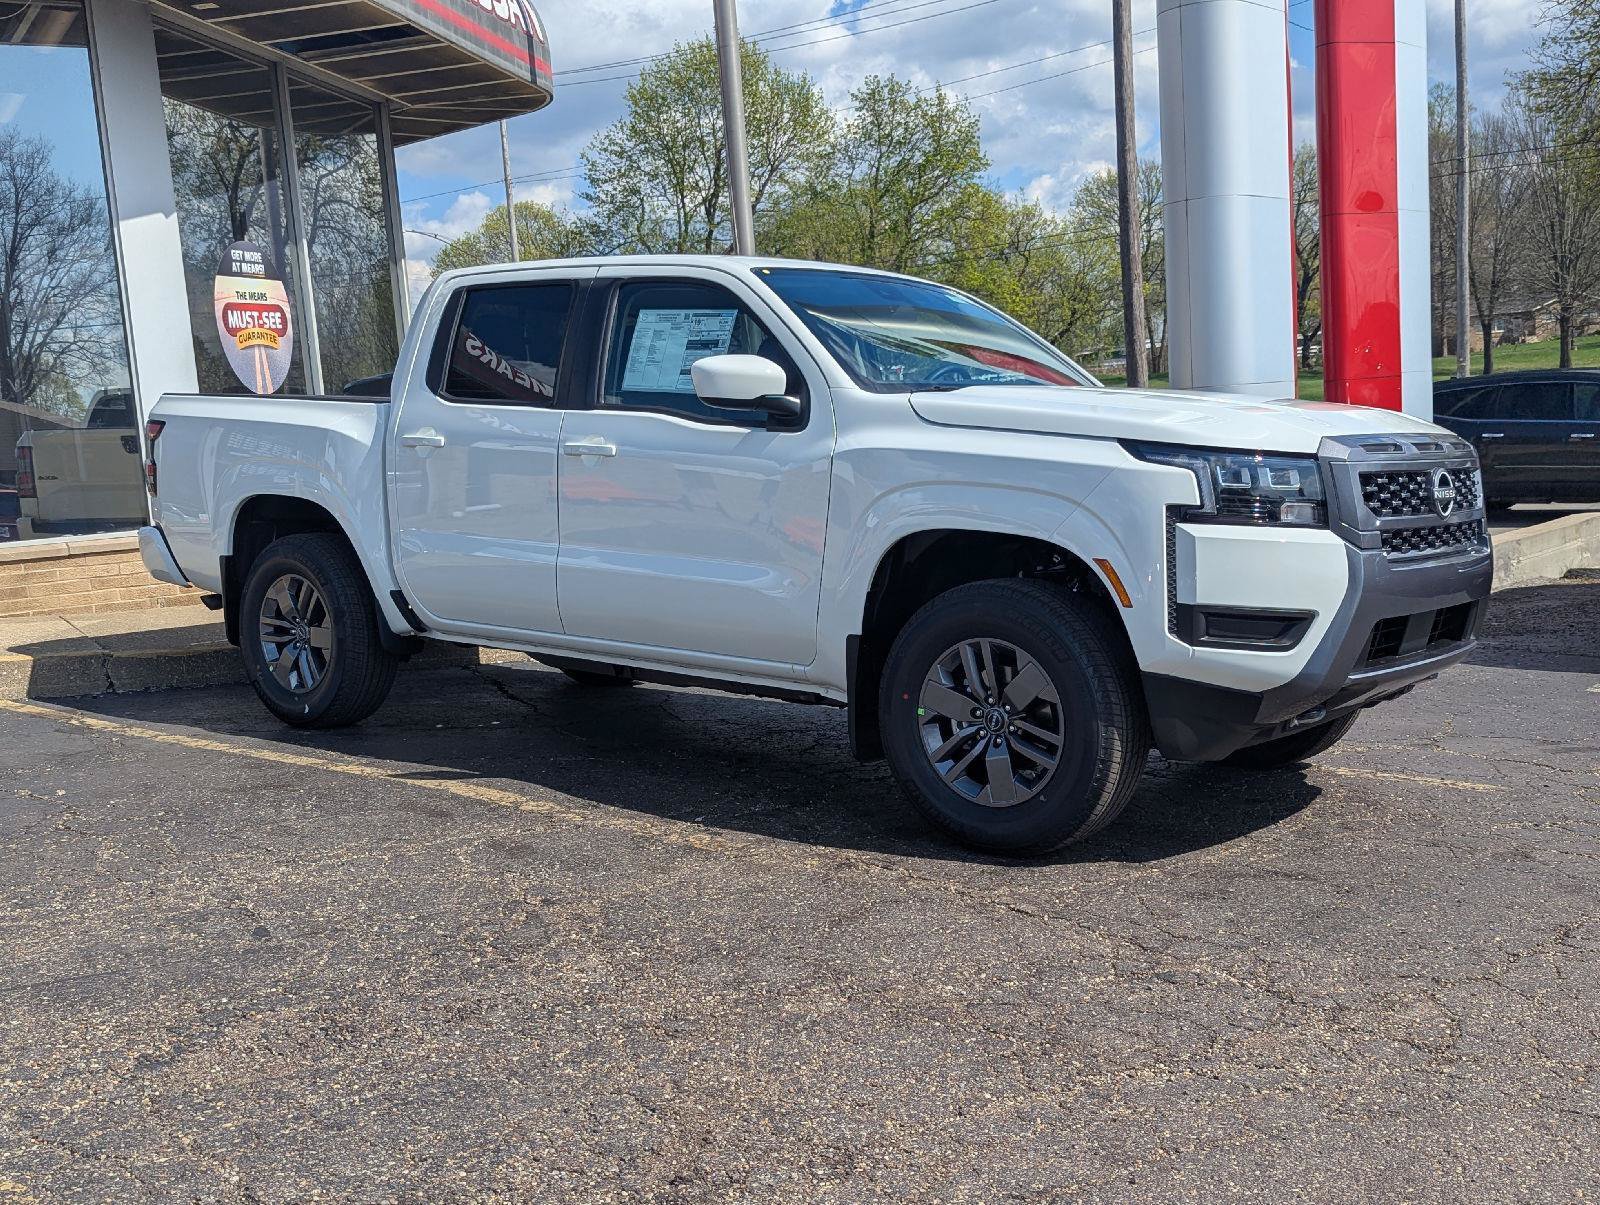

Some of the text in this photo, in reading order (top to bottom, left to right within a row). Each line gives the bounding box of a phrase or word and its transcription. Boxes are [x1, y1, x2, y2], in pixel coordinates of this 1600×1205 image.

[231, 250, 262, 263] GET MORE
[232, 262, 264, 274] AT MEARS!
[236, 291, 267, 301] THE MEARS
[228, 310, 282, 328] MUST-SEE
[239, 331, 278, 344] GUARANTEE
[1434, 490, 1455, 498] NISS
